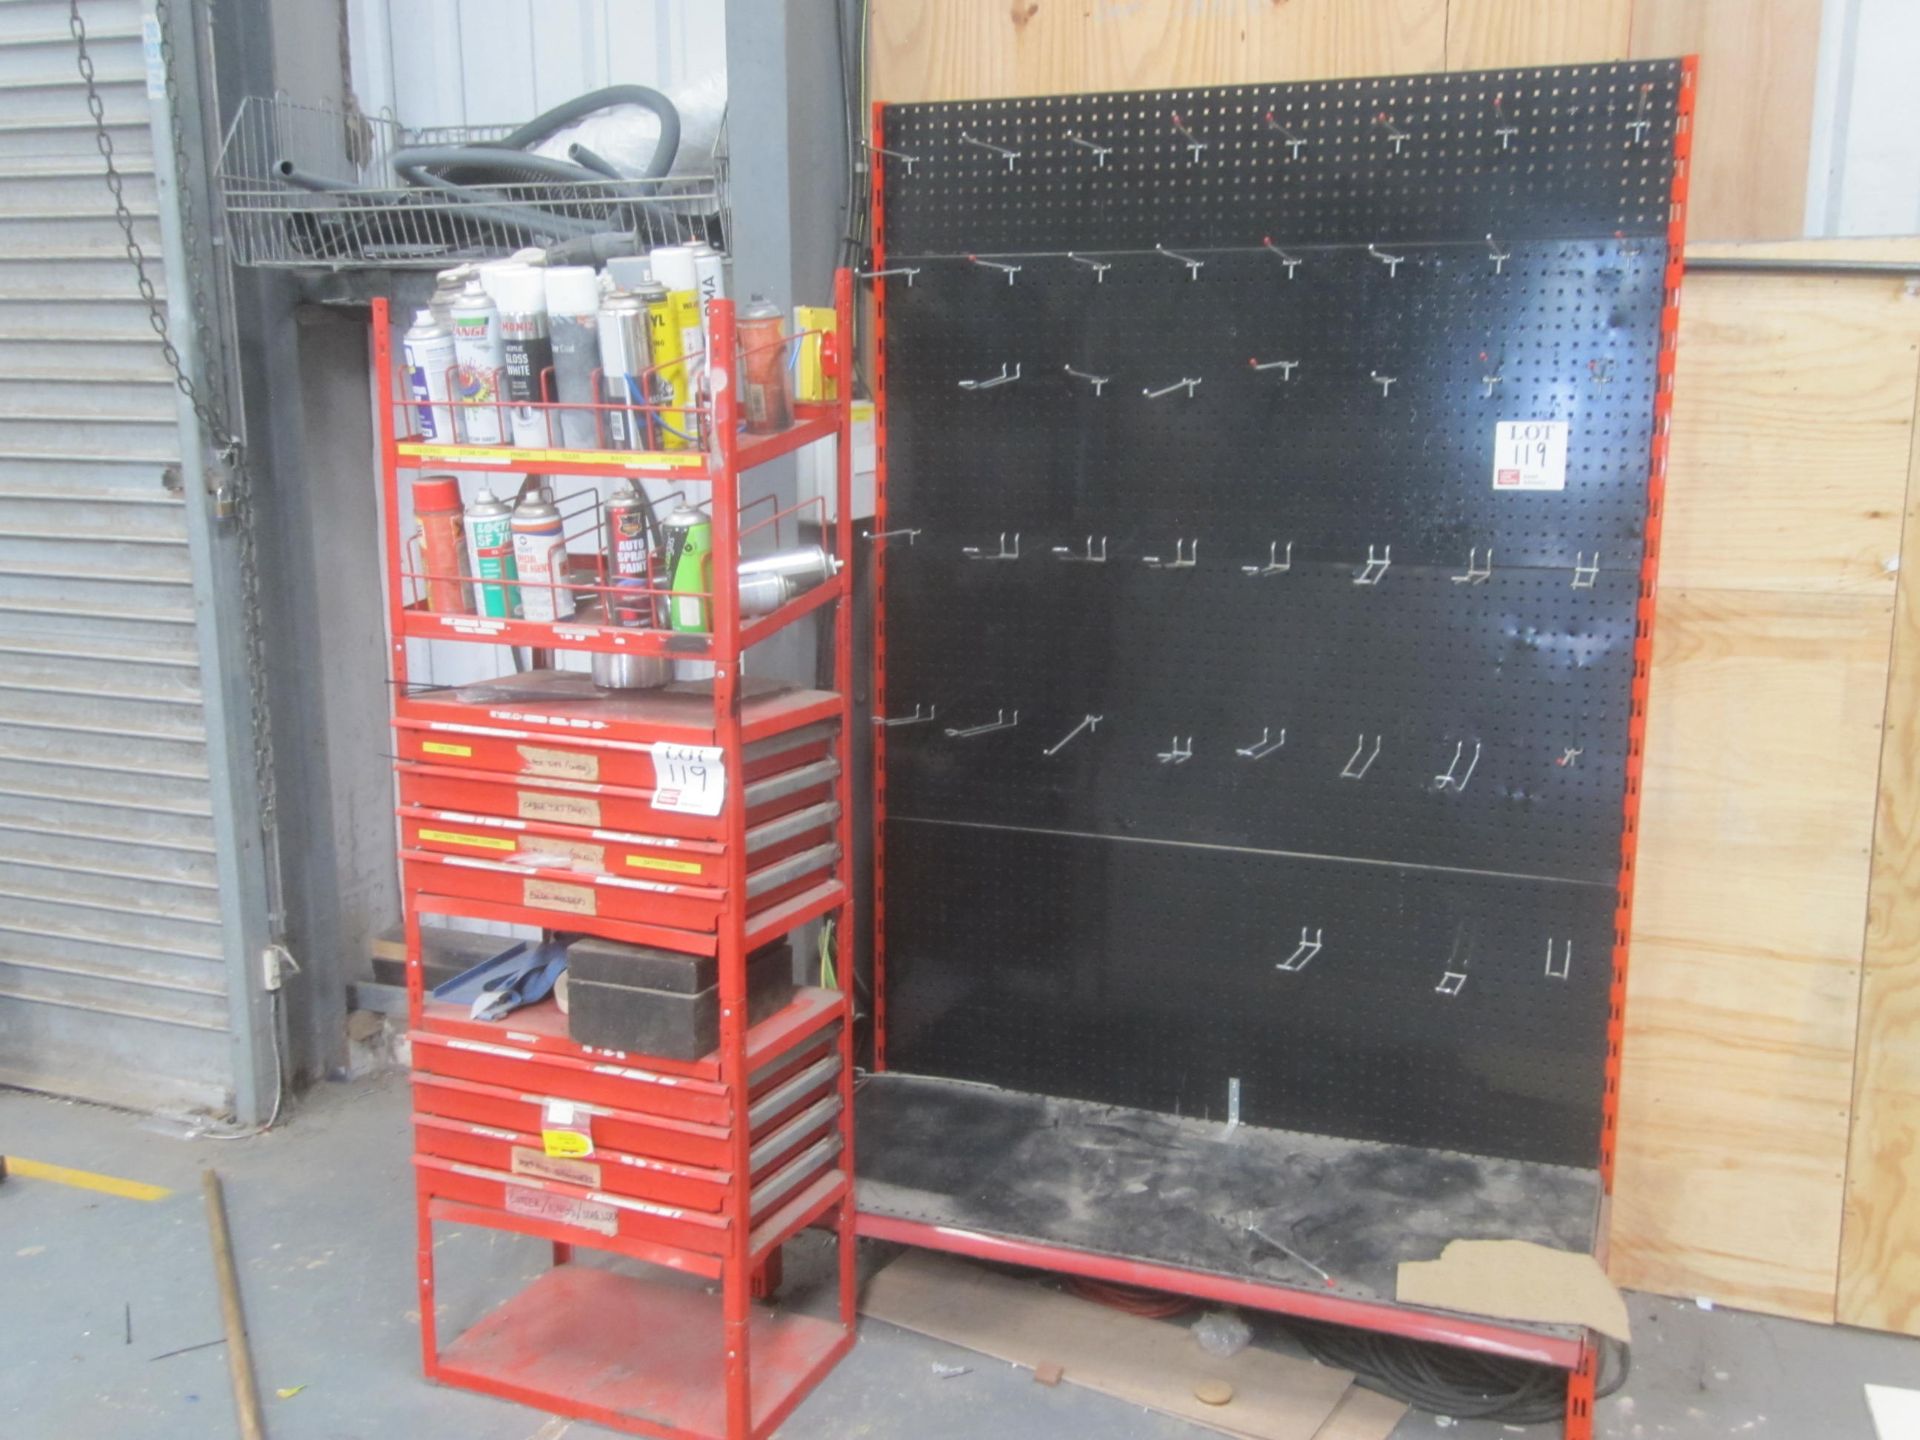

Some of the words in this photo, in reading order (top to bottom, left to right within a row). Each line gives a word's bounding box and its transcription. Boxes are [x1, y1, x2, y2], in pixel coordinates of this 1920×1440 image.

[505, 353, 529, 364] GLOSS
[506, 365, 531, 376] WHITE
[1510, 425, 1556, 441] LOT
[1514, 442, 1546, 468] 119
[618, 540, 645, 551] AUTO
[617, 551, 647, 563] SPRAY
[619, 562, 647, 574] PAINT
[669, 763, 706, 792] 119
